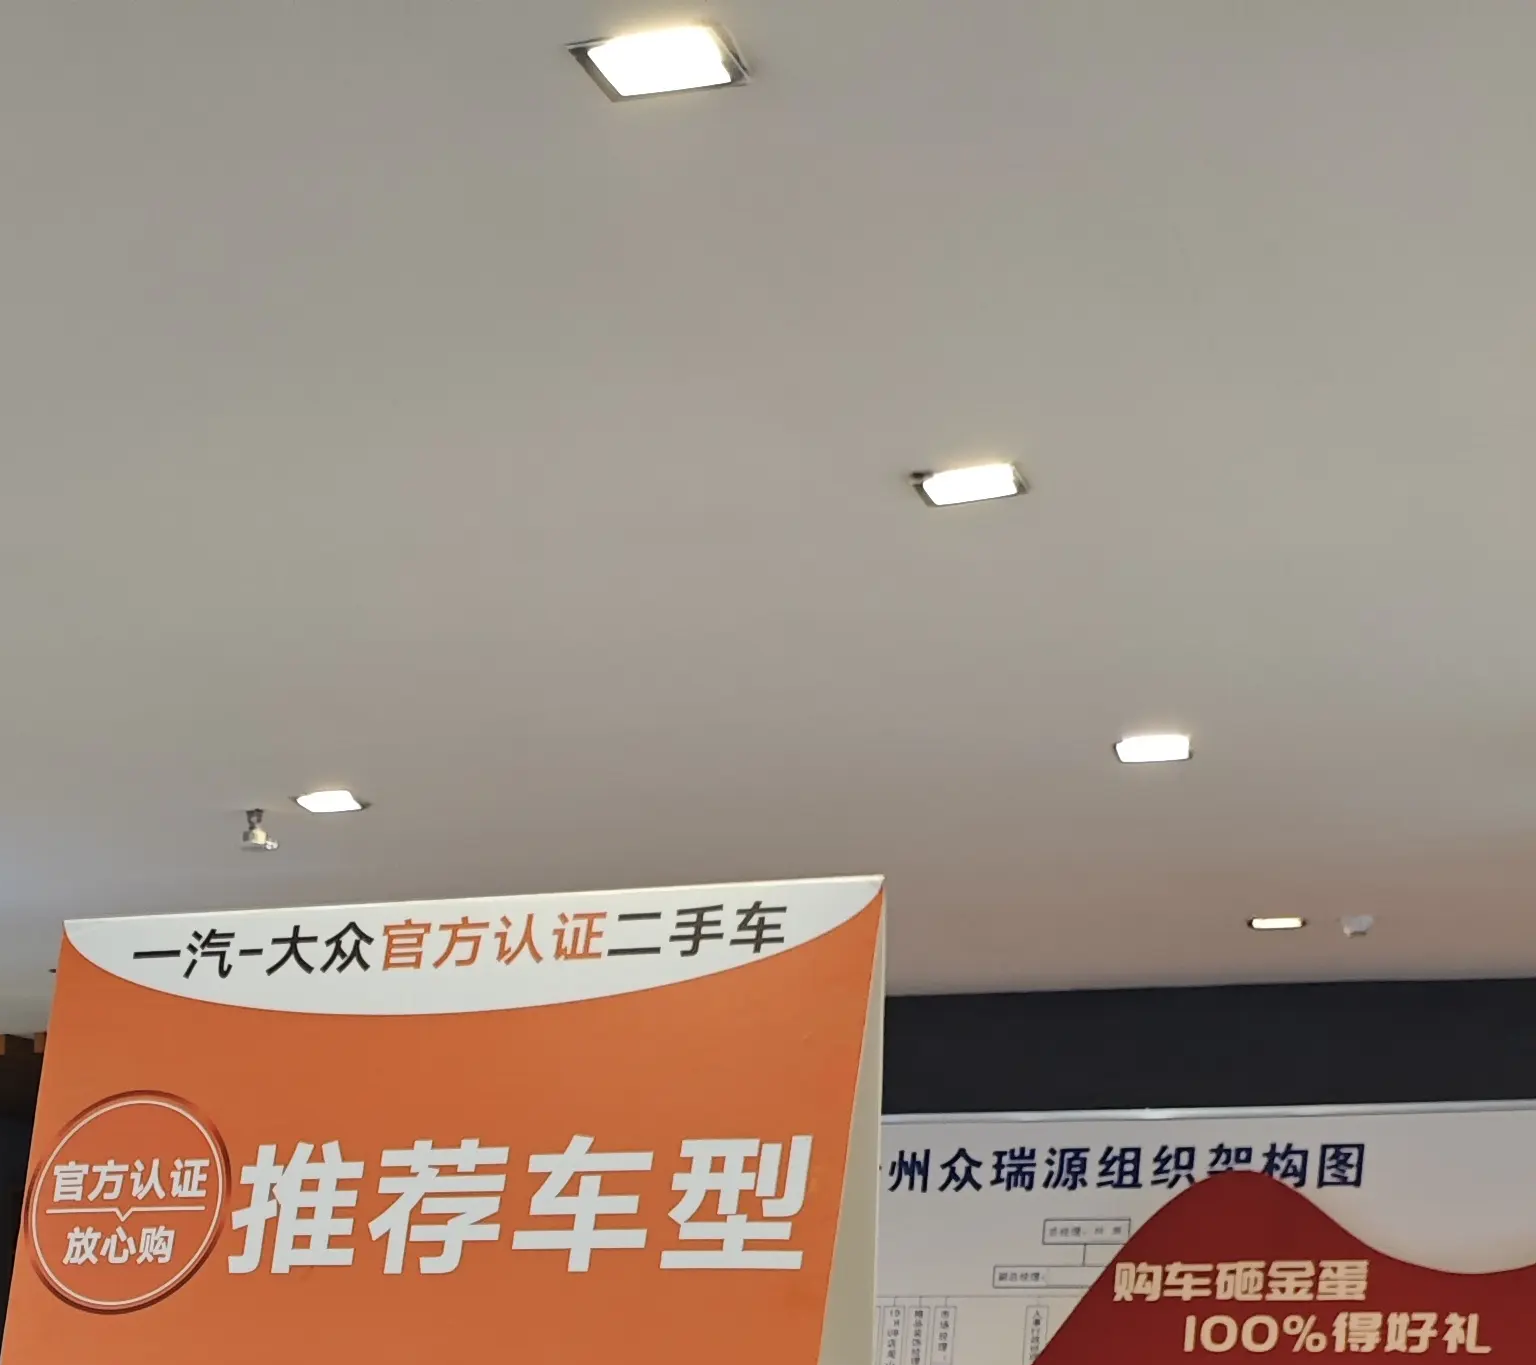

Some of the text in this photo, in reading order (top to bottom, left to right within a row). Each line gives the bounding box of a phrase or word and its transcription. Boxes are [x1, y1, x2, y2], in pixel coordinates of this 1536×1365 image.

[133, 900, 788, 979] 一汽-大众官方认证二手车
[50, 1157, 210, 1202] 官方认证
[879, 1142, 1366, 1194] 州众瑞源组织架构图
[227, 1134, 813, 1274] 推荐车型
[63, 1225, 176, 1266] 放心购
[1112, 1260, 1371, 1303] 购车砸金蛋
[1183, 1311, 1492, 1356] 100%得好礼
